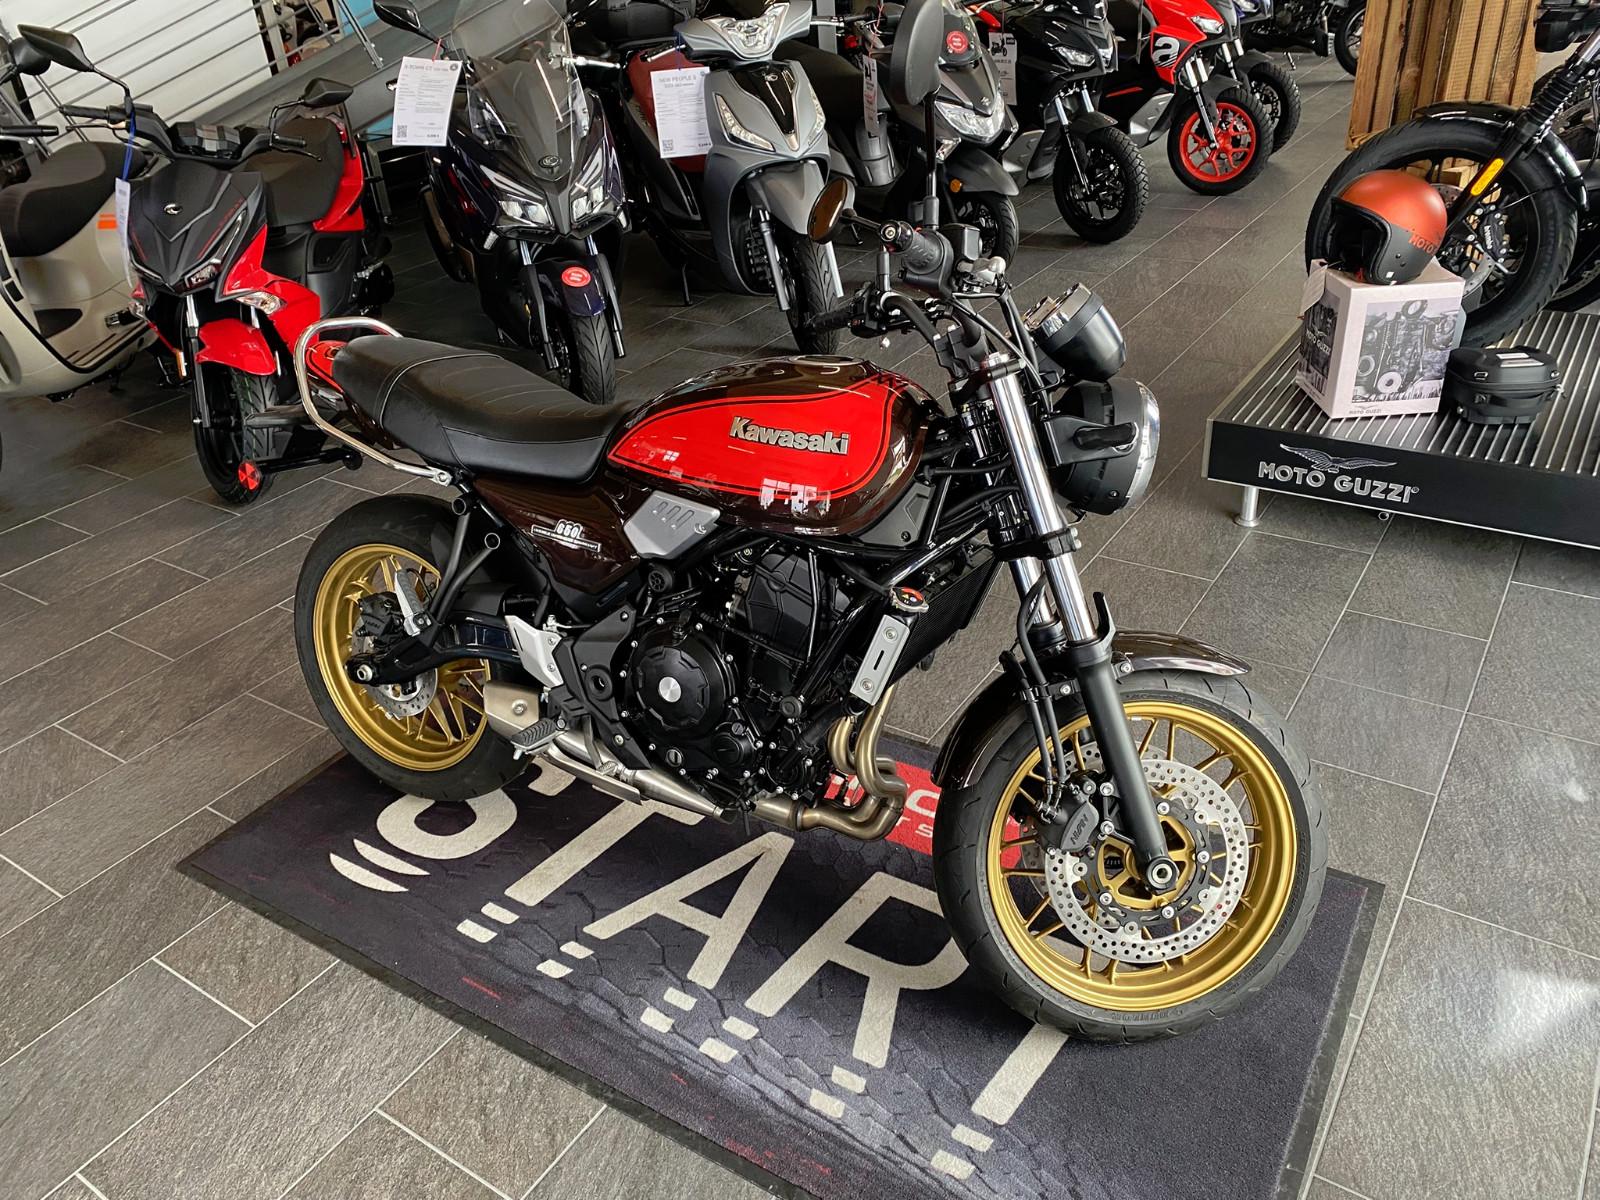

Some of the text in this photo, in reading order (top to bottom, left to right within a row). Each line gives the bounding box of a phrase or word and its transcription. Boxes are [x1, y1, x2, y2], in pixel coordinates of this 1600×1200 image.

[729, 416, 850, 455] Kawasaki
[1258, 461, 1412, 504] MOTO GUZZI
